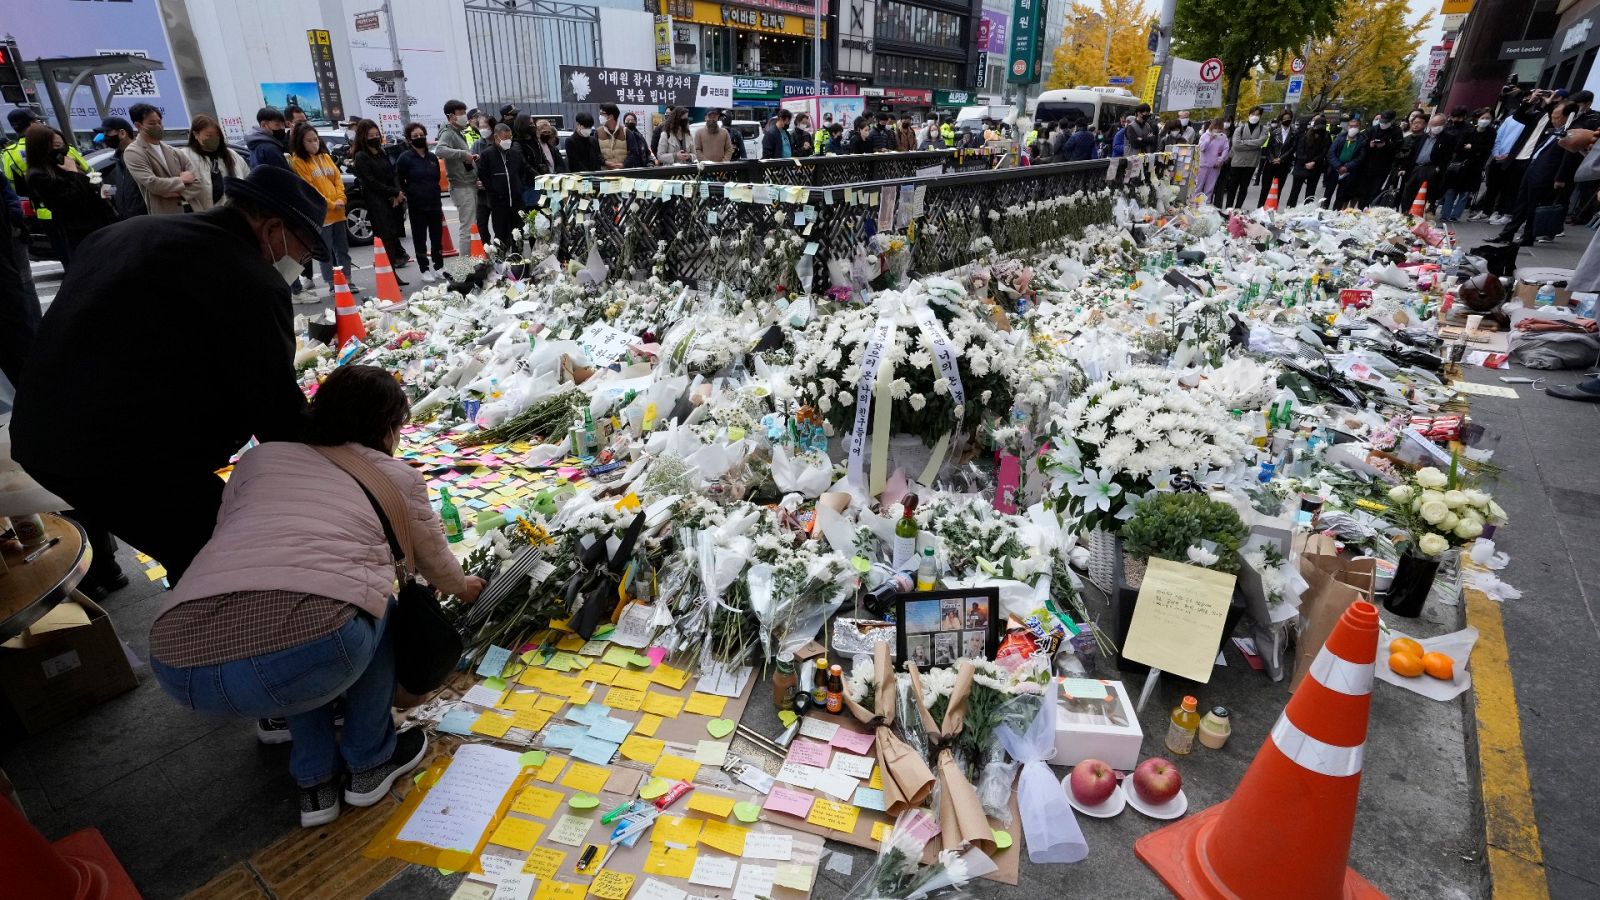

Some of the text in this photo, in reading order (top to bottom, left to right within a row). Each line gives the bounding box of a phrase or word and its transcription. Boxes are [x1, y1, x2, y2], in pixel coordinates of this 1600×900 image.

[731, 8, 757, 26] 이바돔
[977, 53, 985, 87] ALPEDO
[1425, 58, 1441, 88] 부동산
[598, 70, 691, 89] 이태원 참사 희생자의
[754, 79, 773, 89] KEBAB
[616, 88, 677, 103] 명복을 빕니다
[784, 85, 804, 95] EDIYA
[805, 86, 829, 96] COFEE
